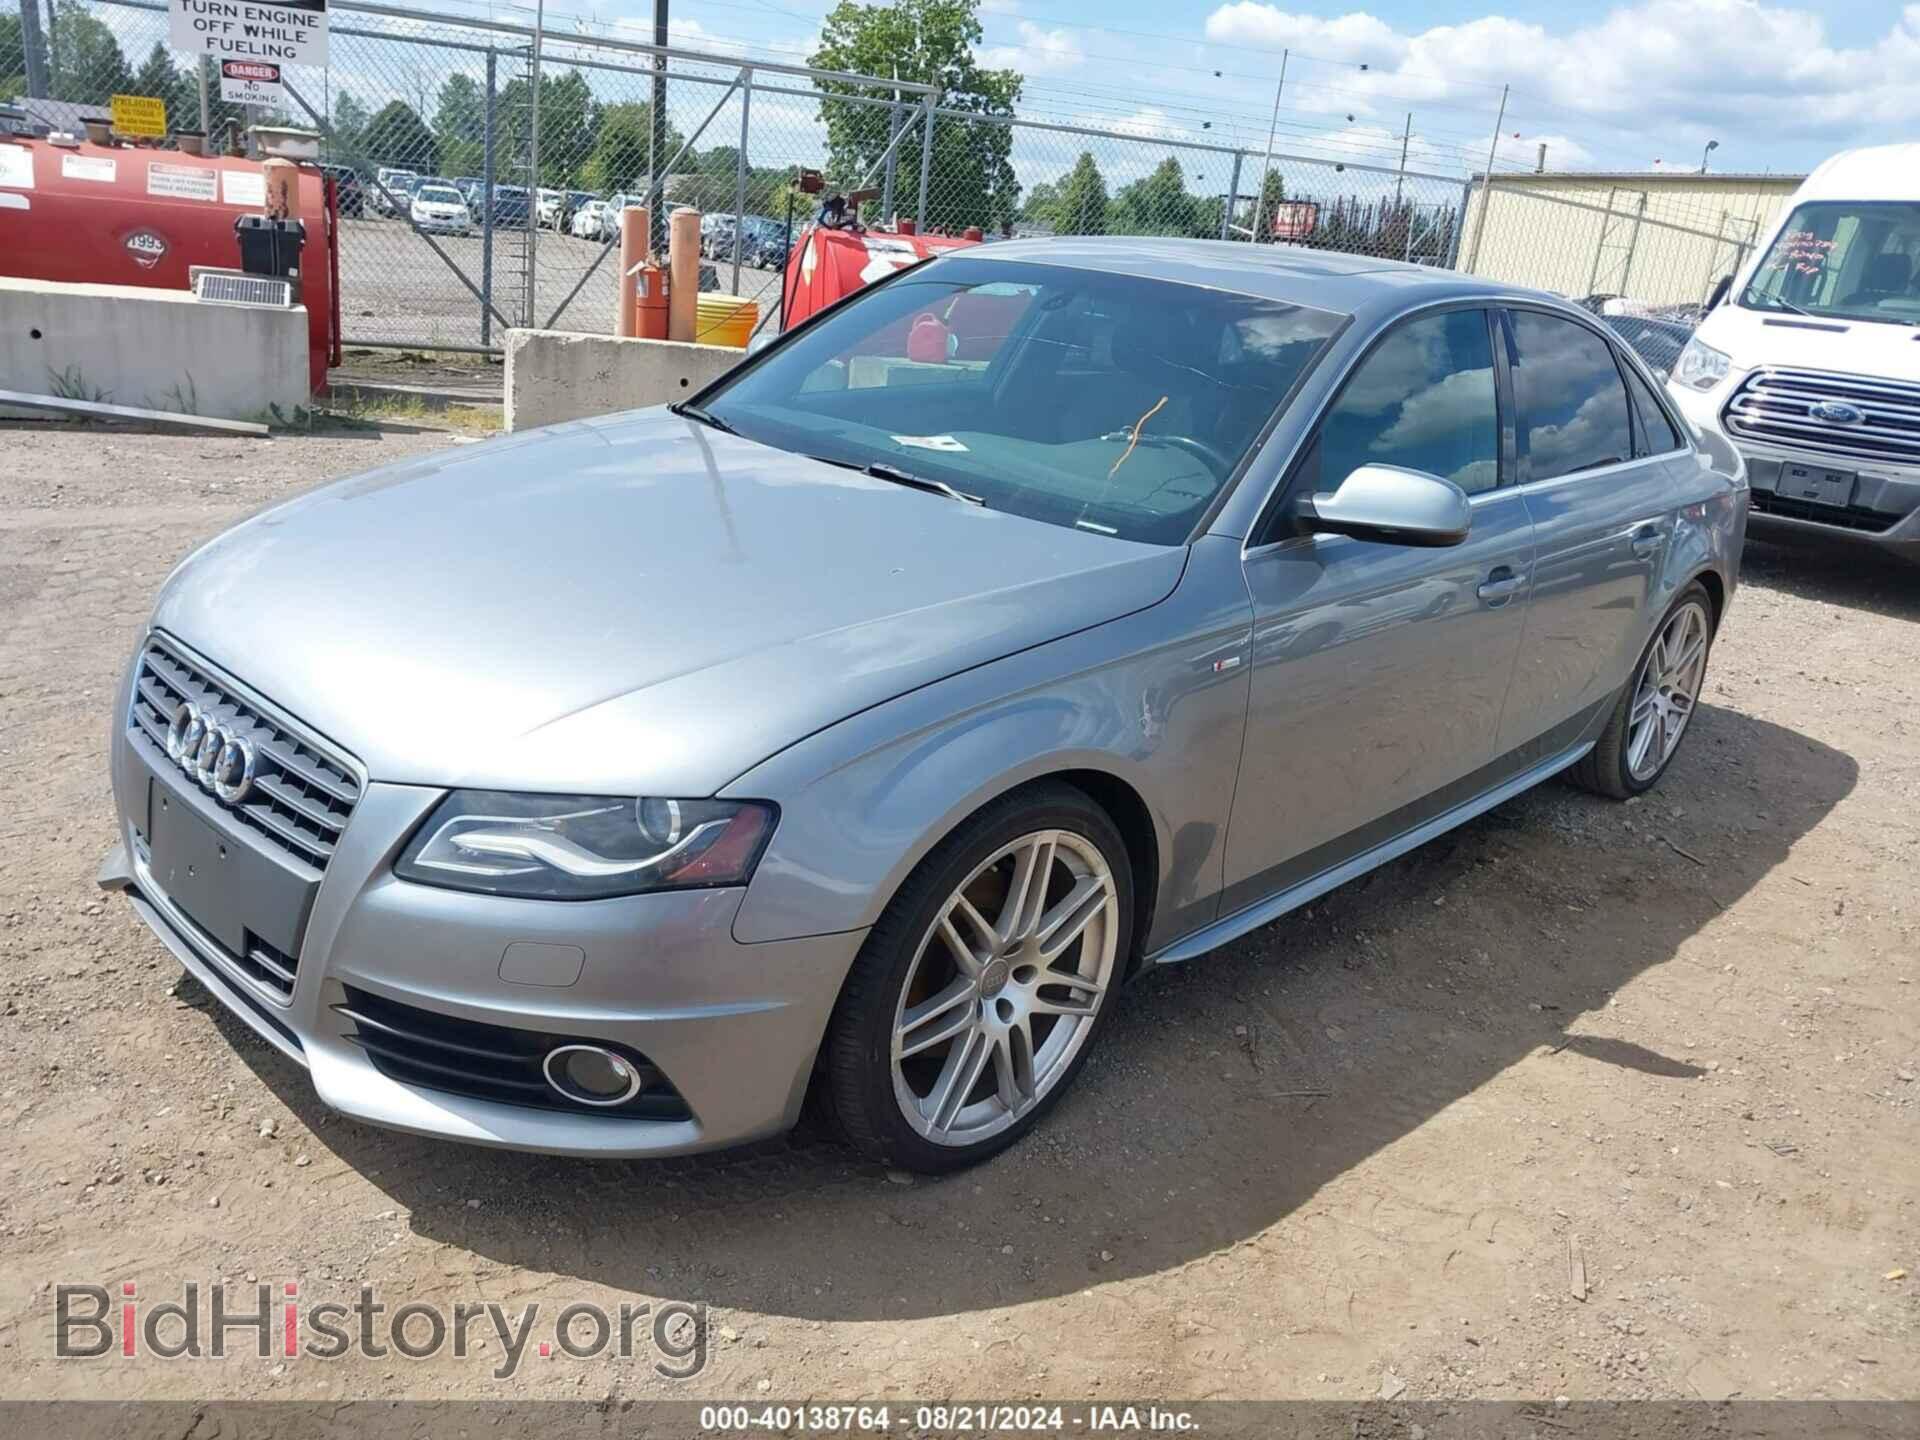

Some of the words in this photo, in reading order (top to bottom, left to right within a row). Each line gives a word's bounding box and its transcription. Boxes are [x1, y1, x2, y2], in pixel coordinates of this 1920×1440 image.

[182, 0, 237, 17] TURN
[245, 8, 319, 28] ENGINE
[194, 18, 235, 34] OFF
[243, 24, 307, 43] WHILE
[206, 37, 296, 59] FUELING
[231, 64, 272, 77] DANGER
[244, 83, 259, 92] NO
[228, 91, 278, 103] SMOKING
